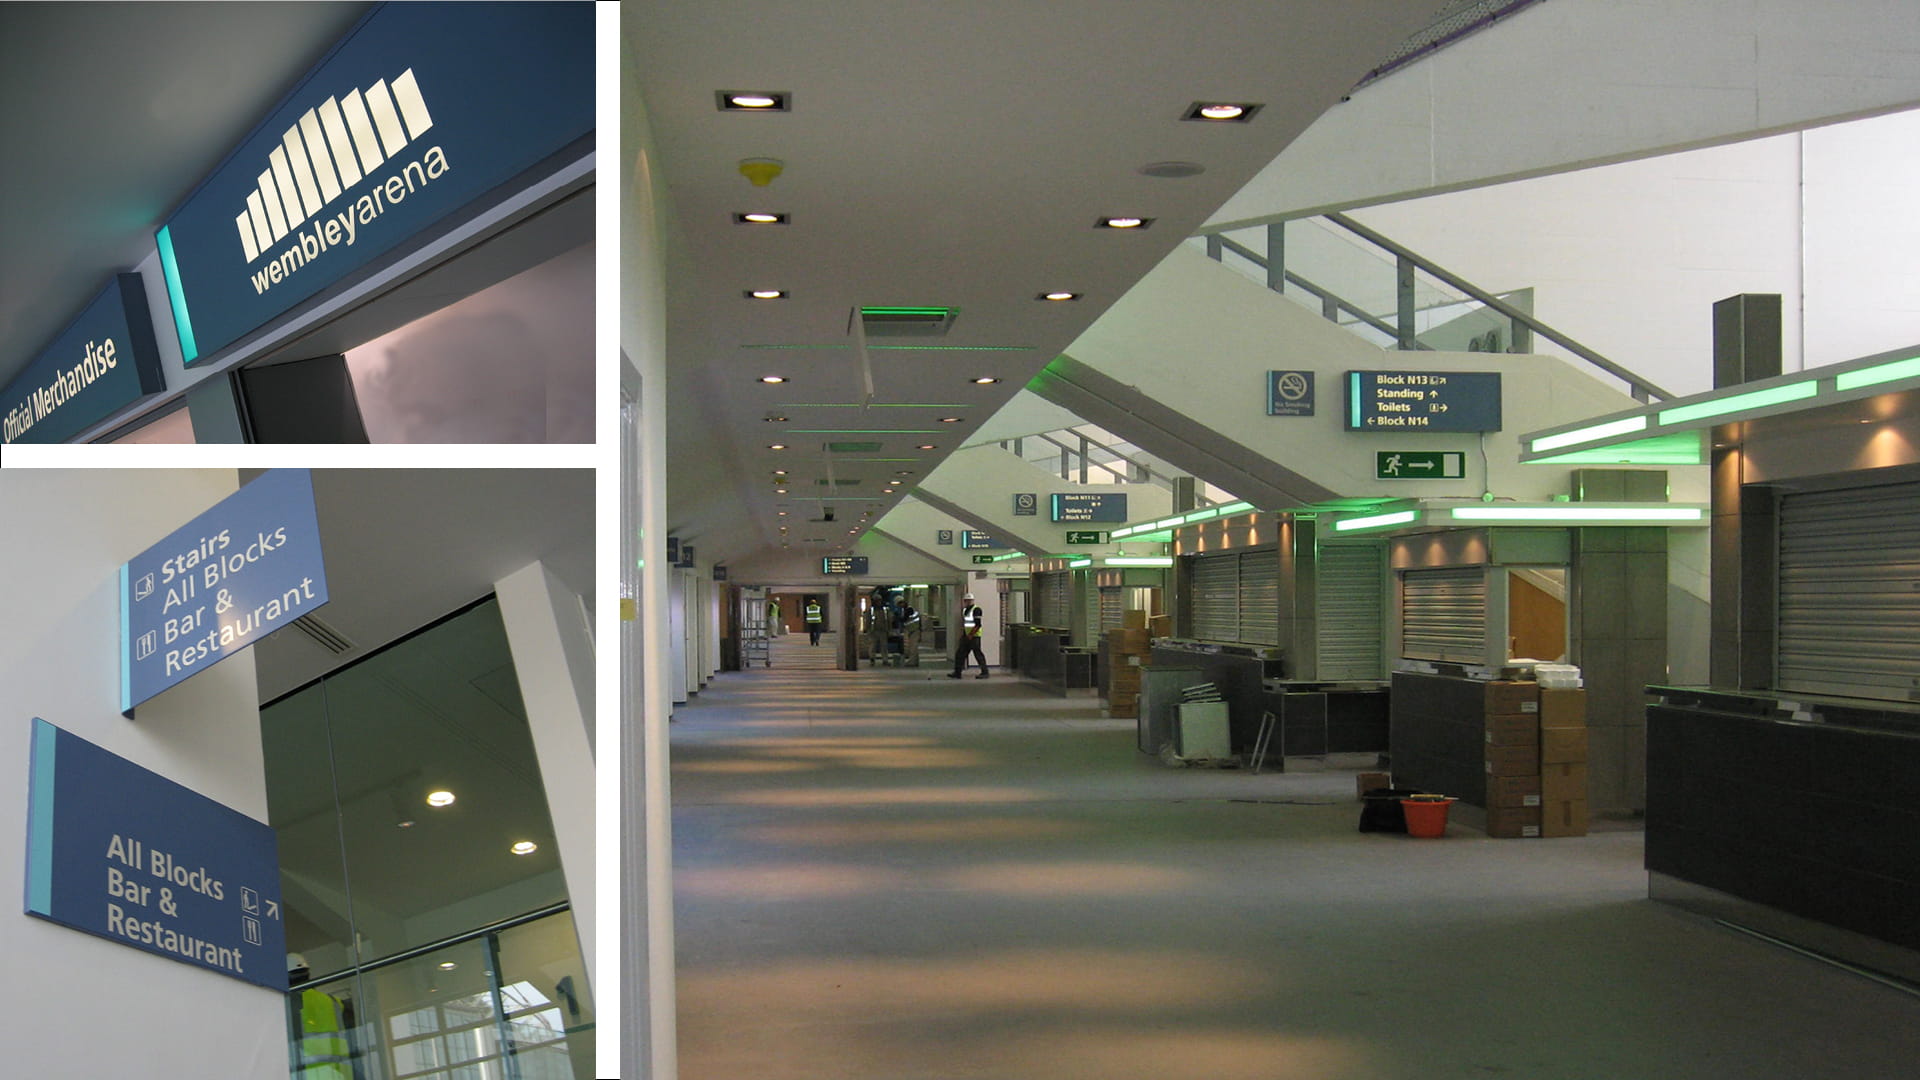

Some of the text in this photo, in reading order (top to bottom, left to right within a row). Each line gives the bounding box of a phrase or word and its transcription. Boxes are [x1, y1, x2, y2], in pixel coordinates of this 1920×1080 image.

[251, 146, 450, 295] wembleyarena
[3, 338, 117, 444] Official Merchandise
[1376, 375, 1428, 385] Block N13
[1376, 388, 1424, 400] Standing
[1376, 402, 1411, 412] Toilets
[1377, 416, 1429, 426] Block N14
[162, 529, 231, 584] Stairs
[163, 527, 287, 615] All Blocks
[164, 588, 234, 644] Bar &
[165, 577, 315, 677] Restaurant
[106, 834, 225, 901] All Blocks
[108, 867, 178, 918] Bar &
[108, 903, 244, 974] Restaurant
